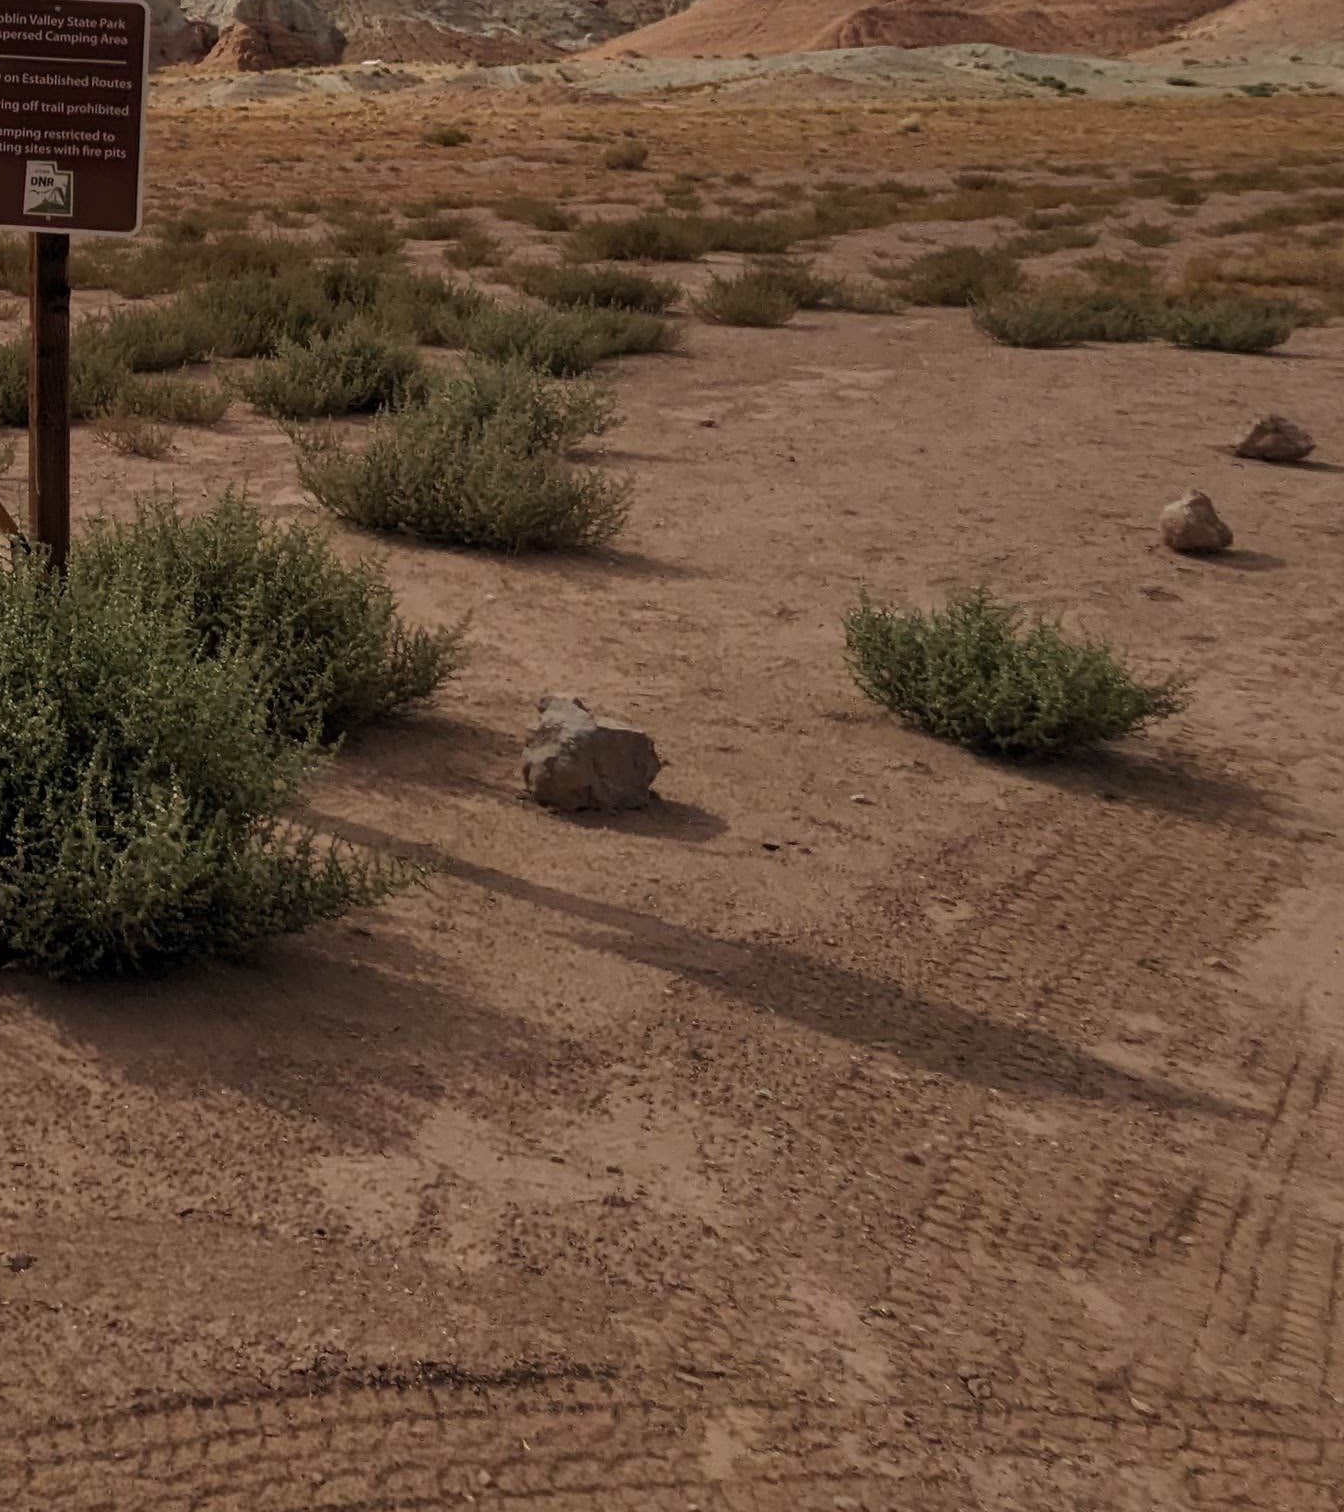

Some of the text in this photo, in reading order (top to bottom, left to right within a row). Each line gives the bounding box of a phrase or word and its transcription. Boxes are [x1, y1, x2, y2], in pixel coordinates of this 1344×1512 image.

[29, 14, 64, 29] Valley
[67, 16, 97, 28] State
[100, 18, 126, 29] Park
[45, 31, 98, 46] Camping
[100, 34, 128, 45] Area
[4, 74, 19, 83] on
[22, 73, 89, 87] Established
[92, 76, 132, 89] Routes
[22, 100, 39, 111] off
[41, 102, 64, 113] trail
[67, 103, 129, 116] prohibited
[44, 129, 100, 141] restricted
[103, 132, 115, 142] to
[25, 143, 51, 155] sites
[53, 144, 80, 156] with
[82, 145, 101, 157] fire
[104, 148, 127, 160] pits
[31, 176, 54, 187] DNR
